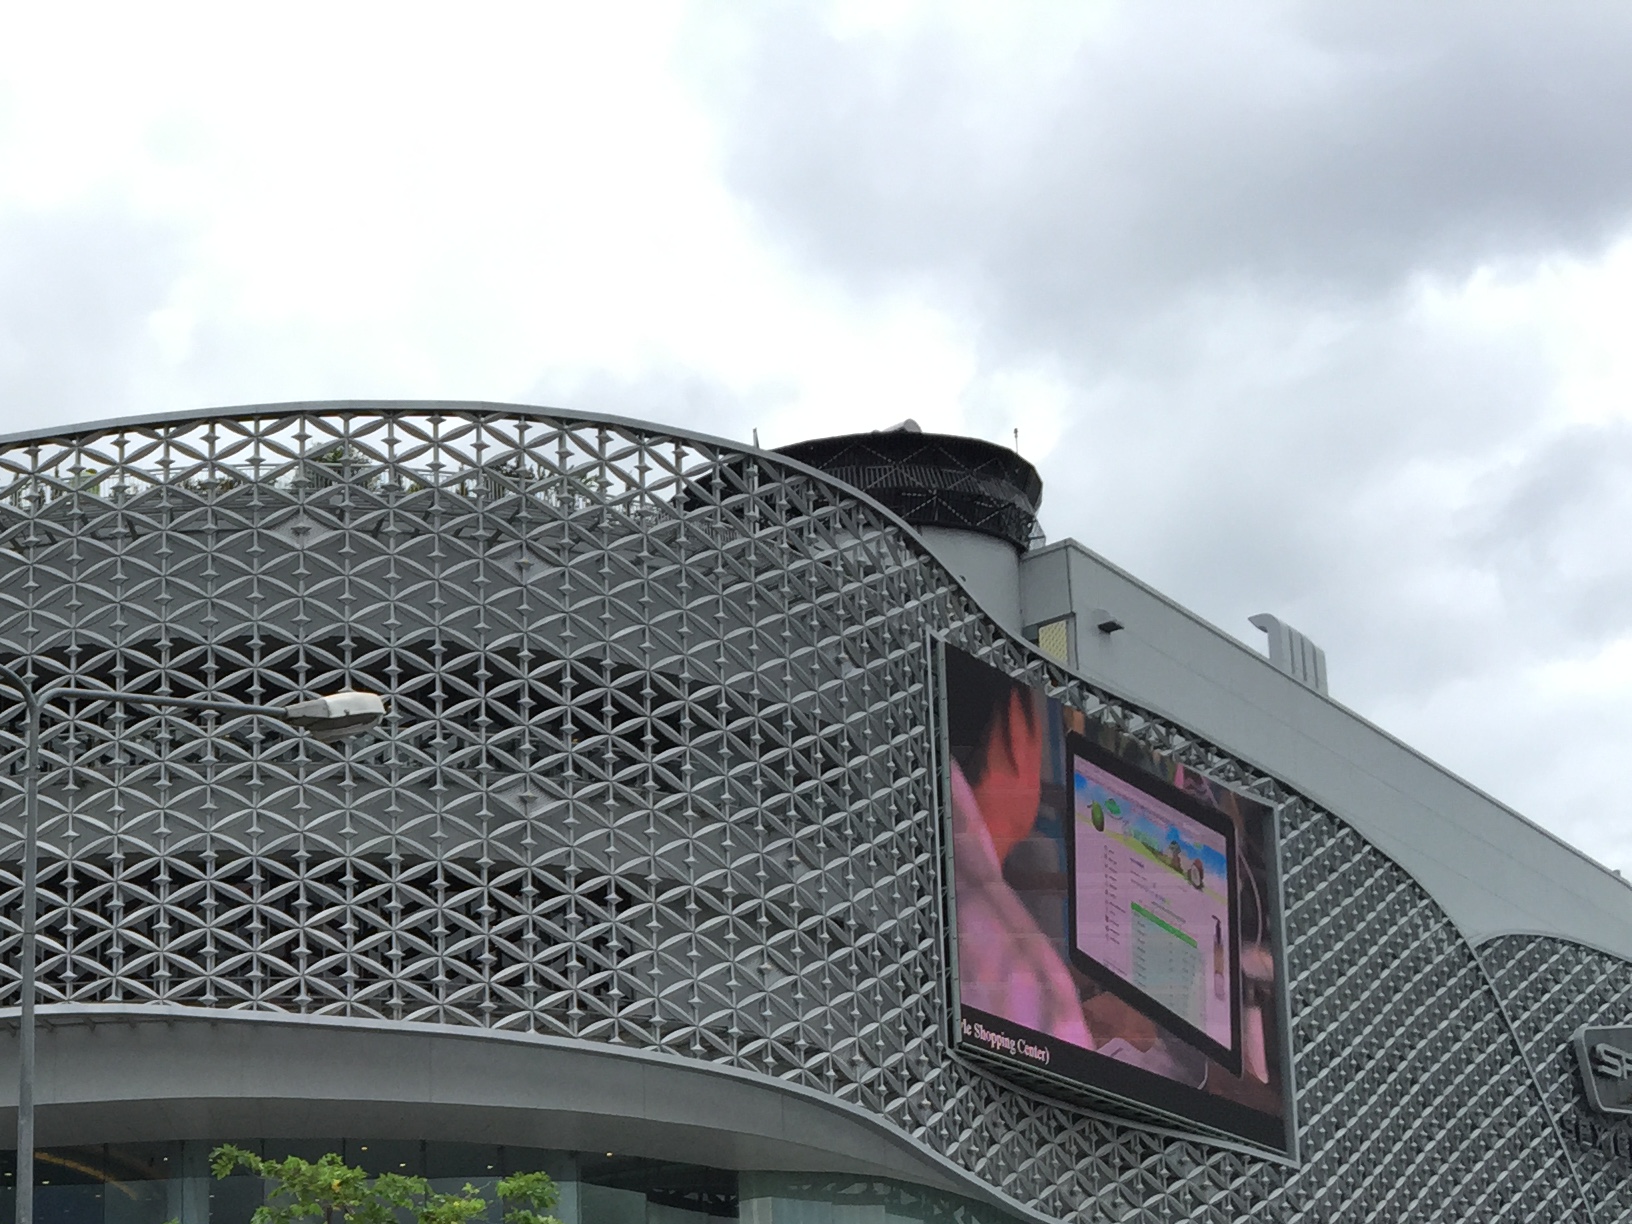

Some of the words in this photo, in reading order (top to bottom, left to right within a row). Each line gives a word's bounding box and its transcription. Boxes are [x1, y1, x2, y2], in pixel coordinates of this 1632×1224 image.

[973, 1022, 1017, 1056] Shopping
[1016, 1038, 1050, 1066] Center)
[1595, 1042, 1632, 1080] S
